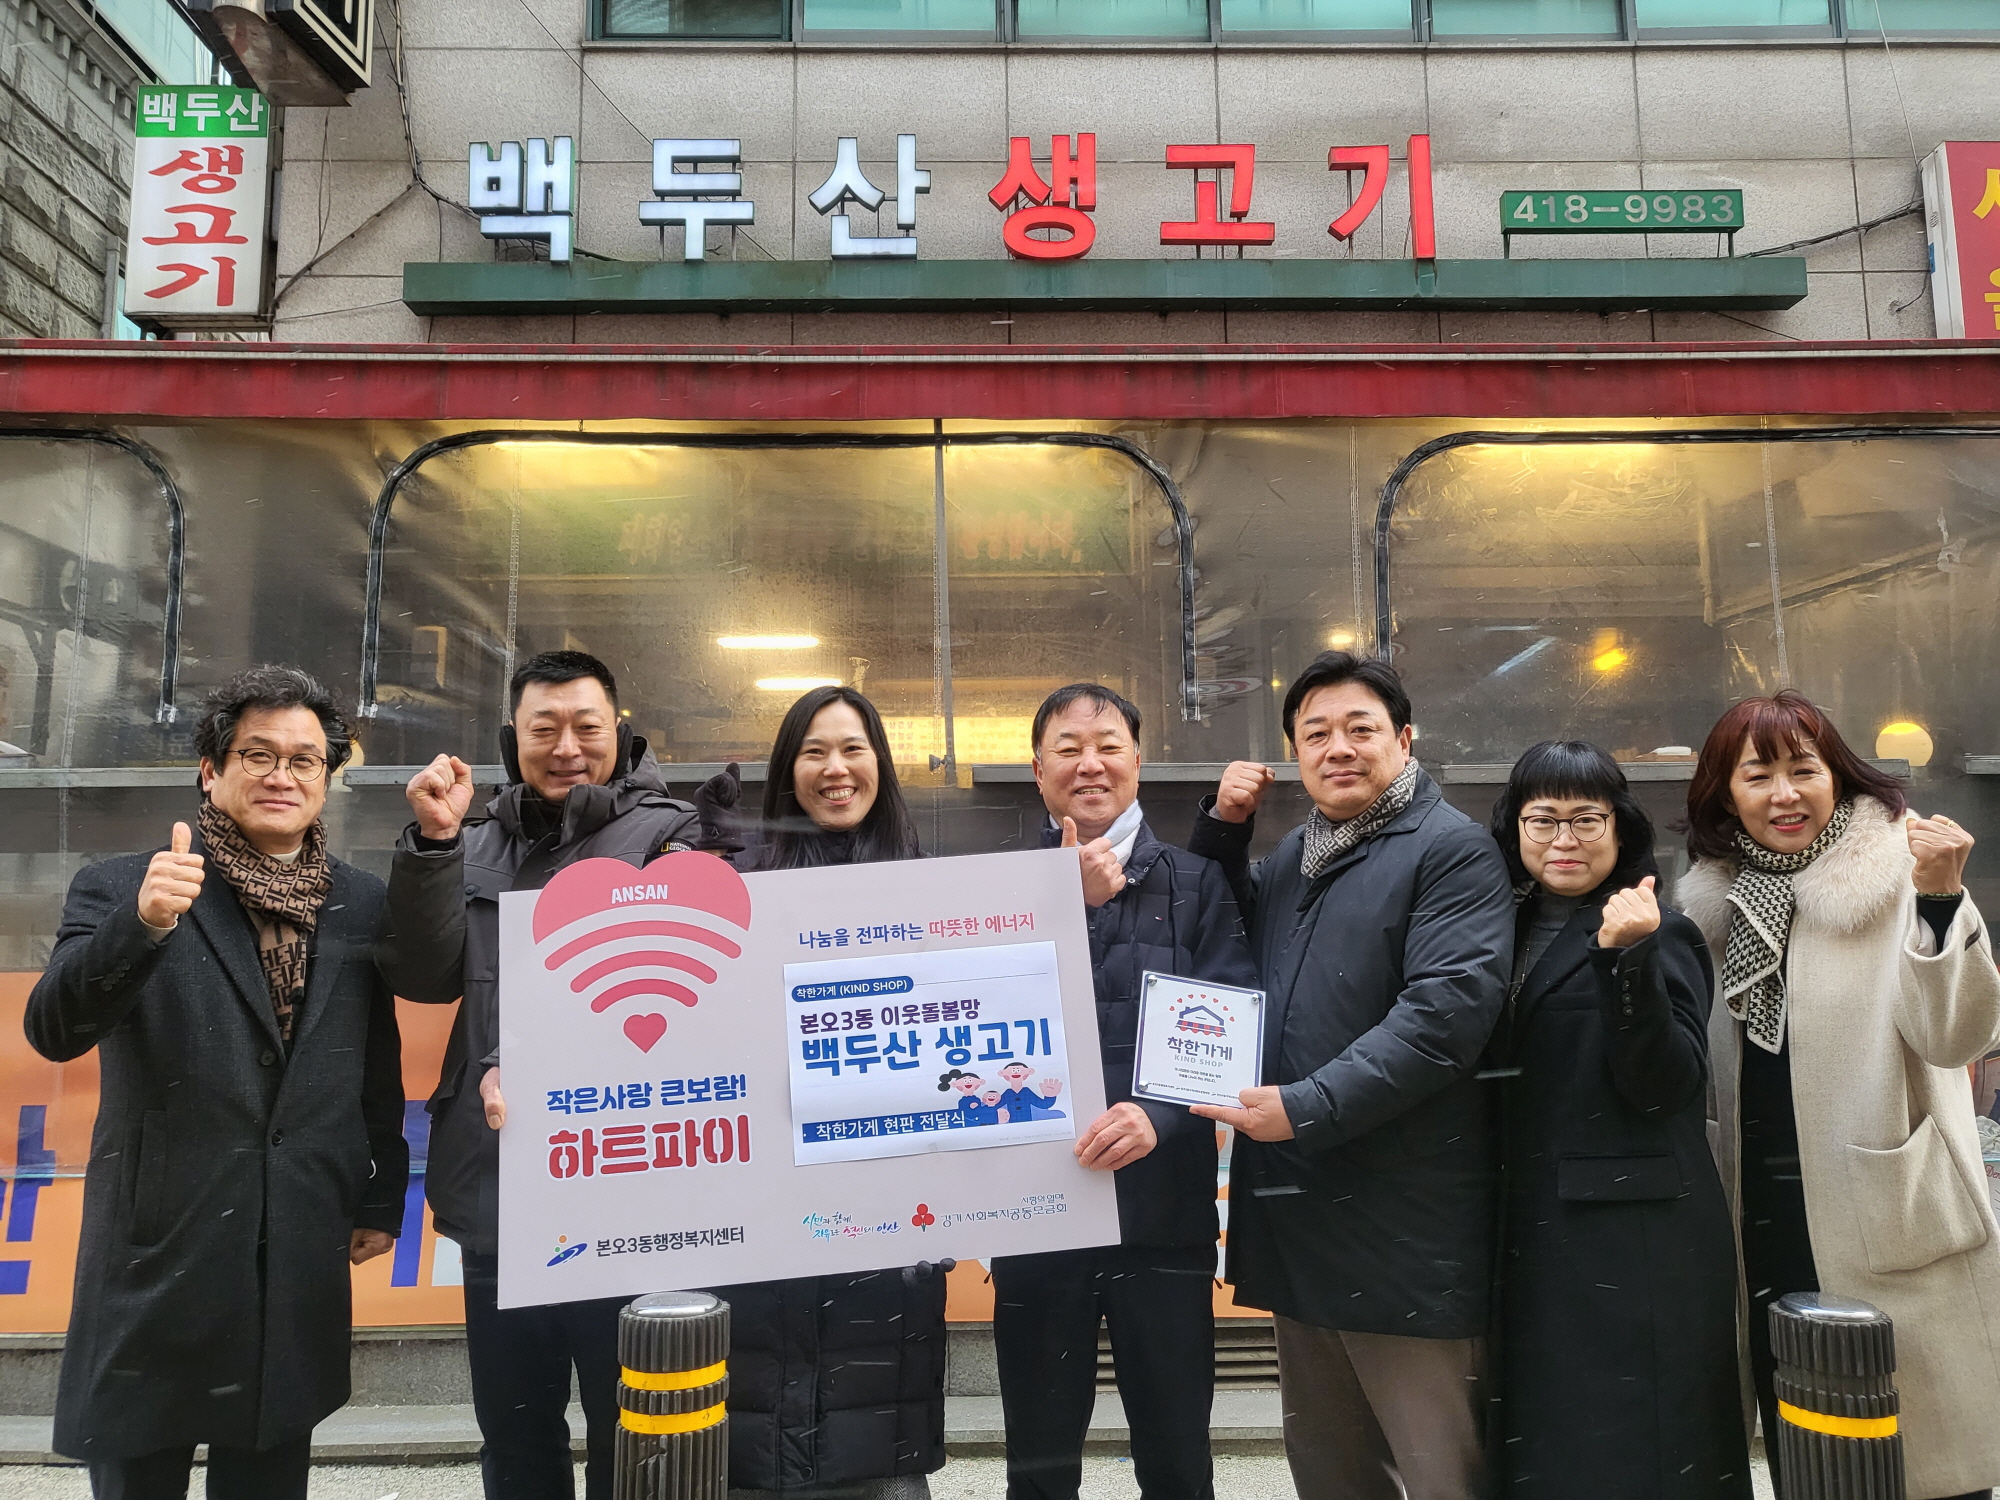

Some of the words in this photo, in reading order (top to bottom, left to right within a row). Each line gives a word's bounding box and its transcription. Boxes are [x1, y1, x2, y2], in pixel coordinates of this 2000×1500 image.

[143, 93, 264, 132] 백두산
[469, 134, 931, 265] 백두산
[988, 133, 1435, 261] 생고기
[1513, 194, 1736, 224] 418-9983
[142, 145, 249, 307] 생고기
[611, 884, 668, 904] ANSAN
[799, 928, 850, 949] 나눔을
[856, 922, 924, 944] 전파하는
[929, 917, 979, 938] 따뜻한
[984, 912, 1035, 934] 에너지
[796, 985, 836, 999] 착한가게
[840, 982, 870, 996] (KIND
[873, 979, 908, 992] SHOP)
[800, 1008, 874, 1035] 본오3동
[881, 998, 980, 1026] 이웃돌봄망
[802, 1030, 922, 1076] 백두산
[935, 1018, 1052, 1066] 생고기
[1167, 1036, 1233, 1061] 착한가게
[1174, 1054, 1197, 1064] KIND
[1199, 1058, 1223, 1068] SHOP
[547, 1082, 652, 1114] 작은사랑
[660, 1074, 747, 1105] 큰보람!
[816, 1121, 879, 1141] 착한가게
[884, 1115, 915, 1135] 현판
[919, 1110, 966, 1131] 전달식
[548, 1114, 751, 1179] 하트파이
[803, 1212, 830, 1231] 시민과
[876, 1221, 901, 1234] 안산
[596, 1226, 745, 1257] 본오3동행정복지센터
